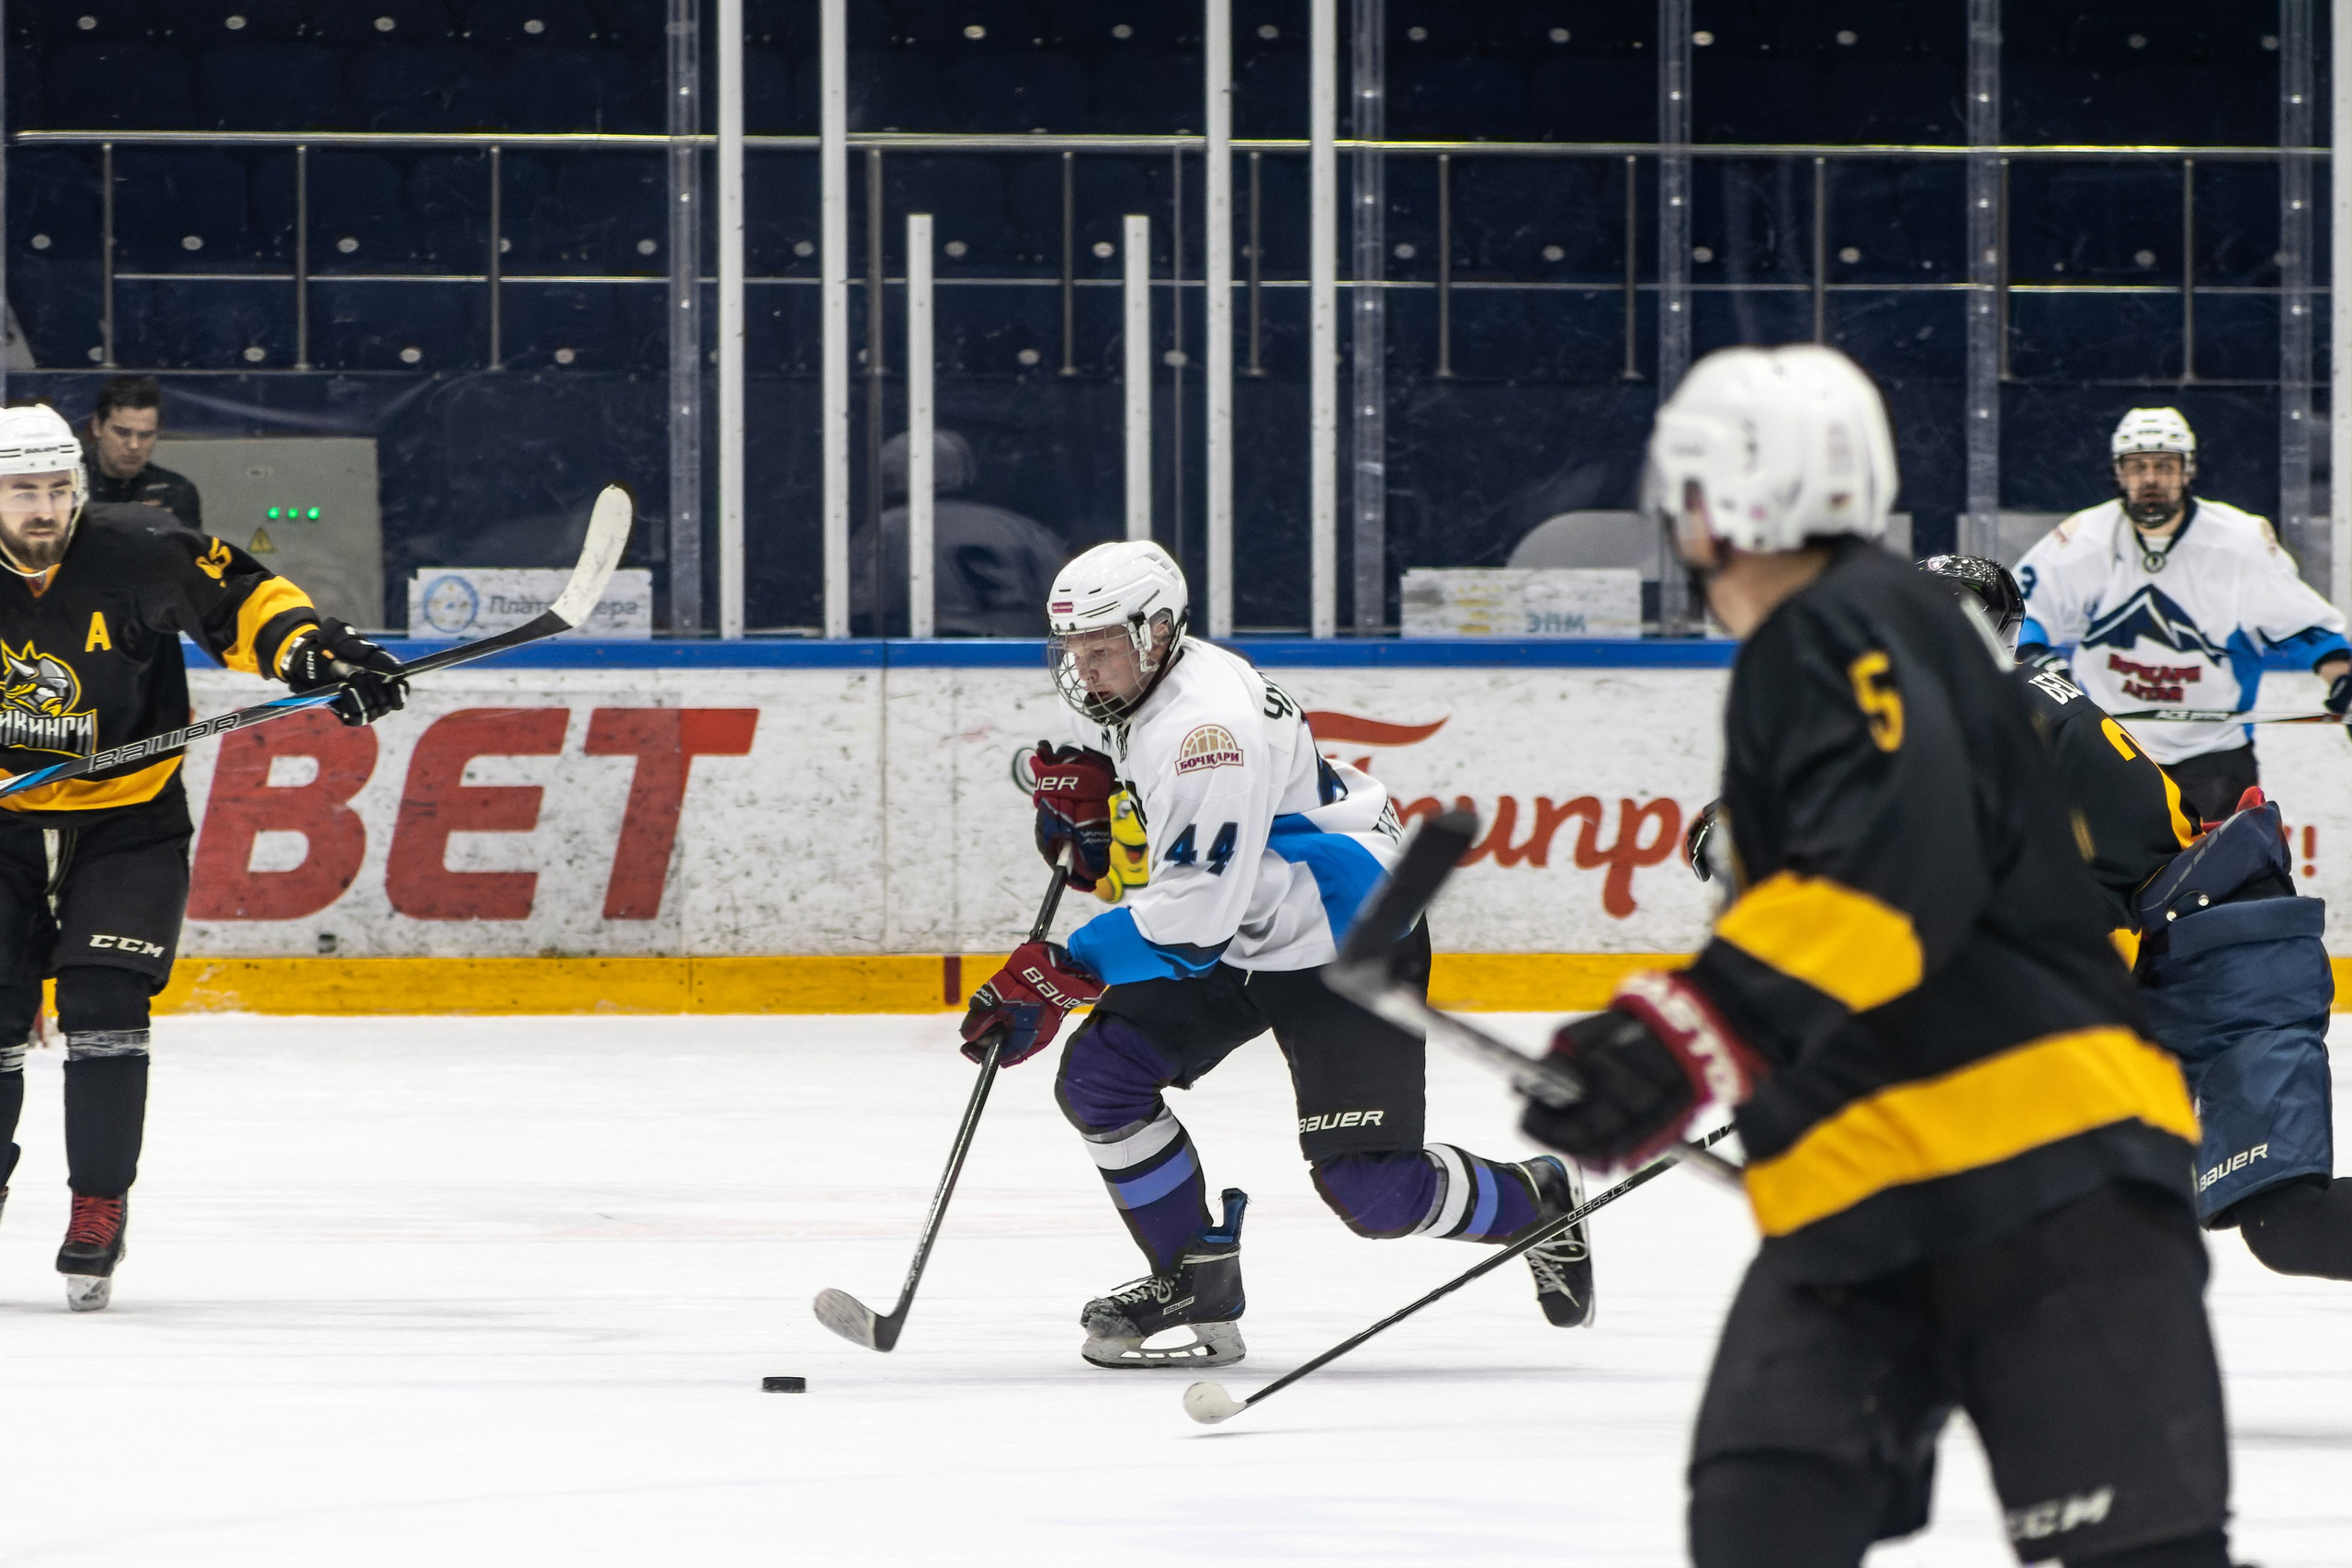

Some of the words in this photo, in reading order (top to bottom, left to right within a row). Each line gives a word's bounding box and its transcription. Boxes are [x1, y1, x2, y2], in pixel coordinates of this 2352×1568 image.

[85, 612, 112, 652] A
[1849, 649, 1905, 752] 5
[0, 711, 93, 756] ИКИНГИ
[88, 713, 241, 773] BAUER
[1180, 751, 1239, 771] БОЧКАРИ
[1163, 821, 1238, 877] 44
[88, 934, 165, 958] CCM
[1022, 966, 1082, 1010] BAUE
[1299, 1110, 1385, 1134] BAUER
[2199, 1143, 2268, 1193] BAUER
[1567, 1179, 1634, 1222] JETSPEED
